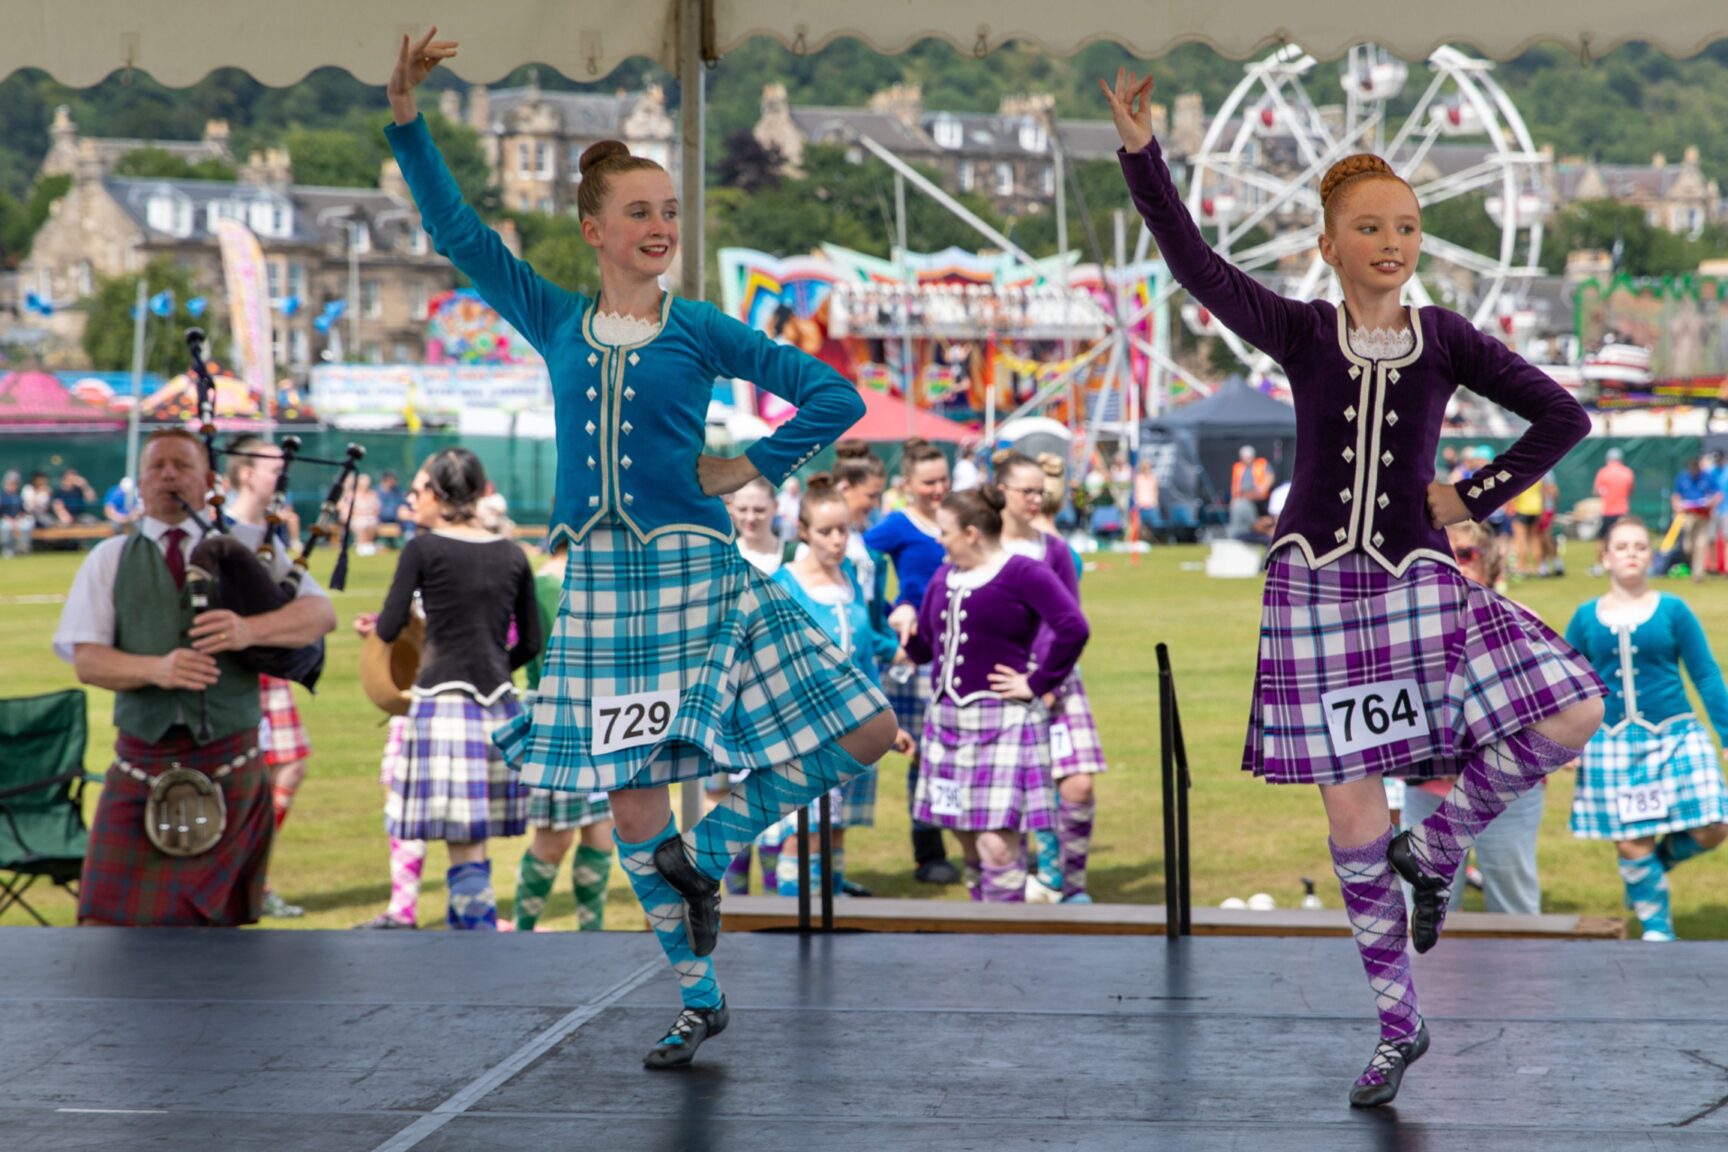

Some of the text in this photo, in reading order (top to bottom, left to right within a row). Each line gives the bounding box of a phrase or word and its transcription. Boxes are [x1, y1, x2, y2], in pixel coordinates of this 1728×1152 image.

[599, 700, 671, 745] 729
[1331, 688, 1419, 743] 764
[1621, 789, 1662, 814] 785
